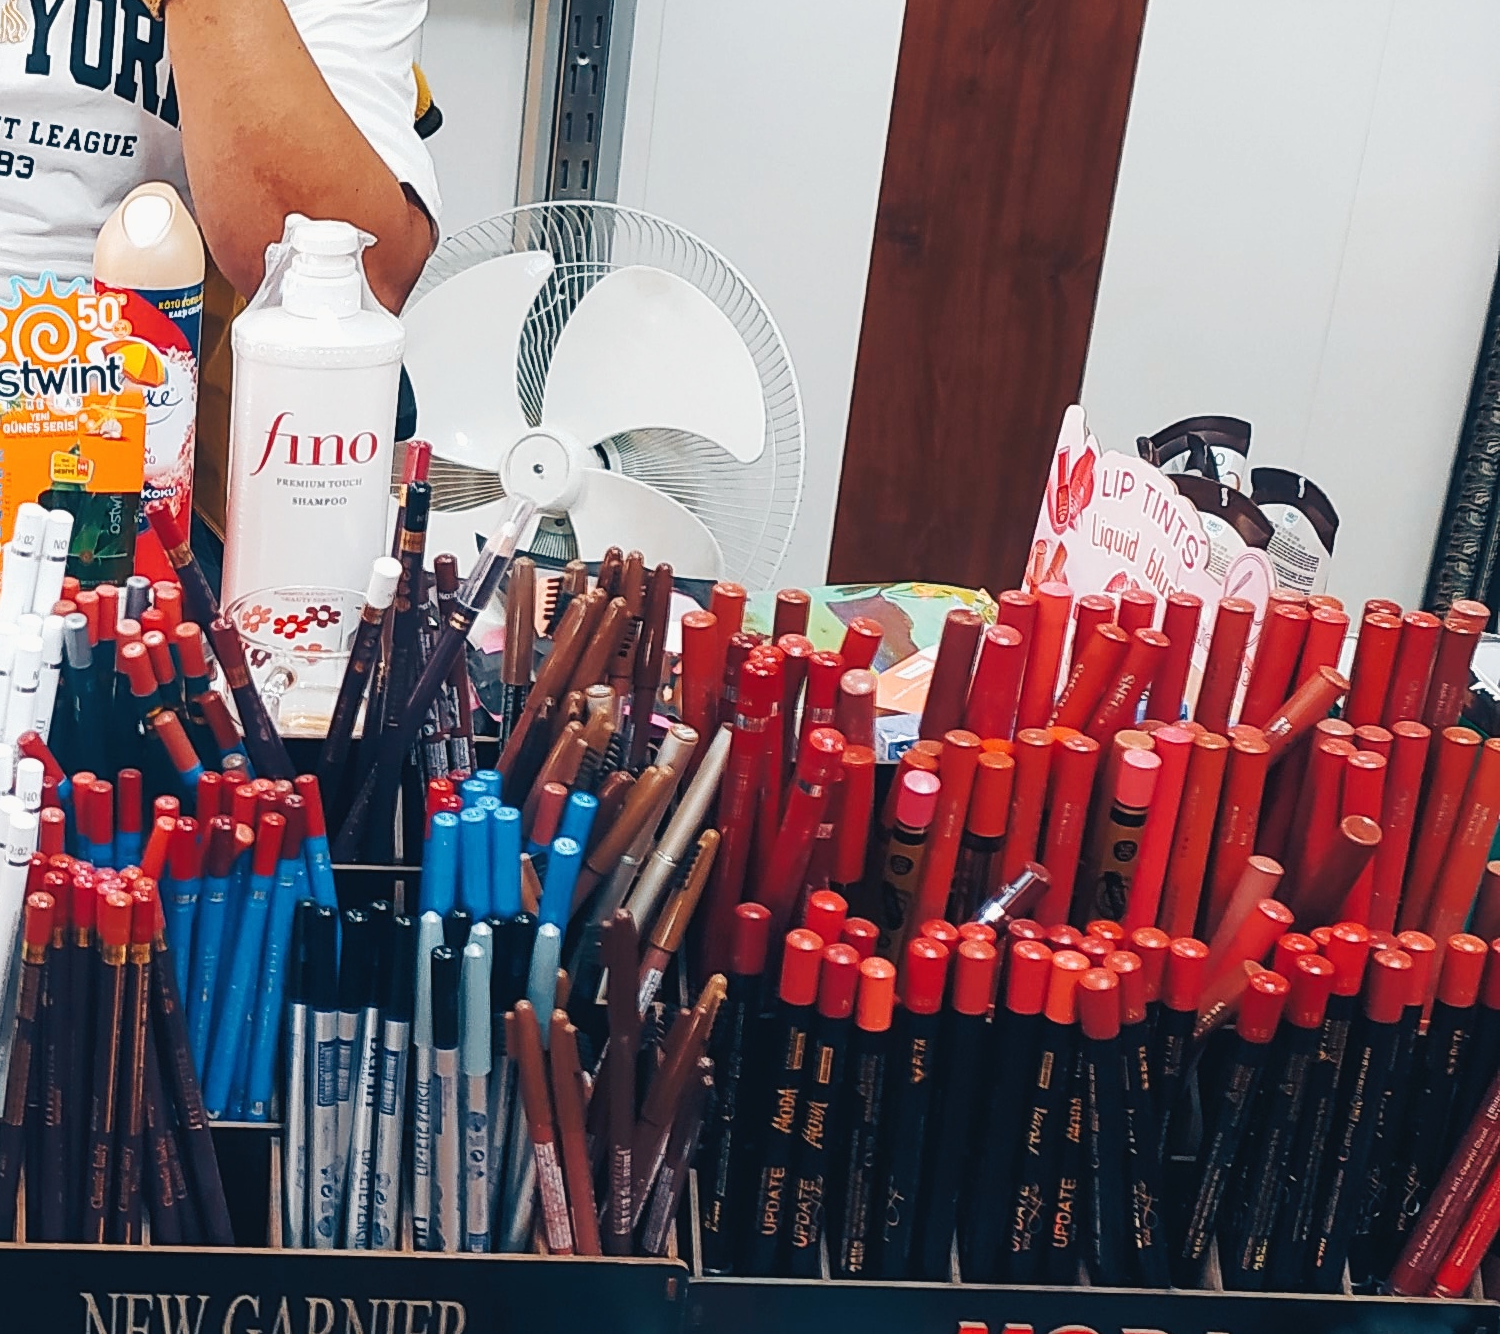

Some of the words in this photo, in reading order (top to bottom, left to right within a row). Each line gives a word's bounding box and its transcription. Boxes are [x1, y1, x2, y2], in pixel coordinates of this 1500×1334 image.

[28, 121, 138, 158] LEAGUE
[3, 421, 40, 435] GÜNEŞ
[250, 412, 378, 476] fino
[276, 478, 326, 488] PREMIUM
[327, 478, 362, 488] TOUCH
[292, 496, 348, 506] SHAMPOO
[1092, 513, 1140, 562] Liquid
[1102, 469, 1135, 499] LIP
[1143, 482, 1198, 569] TINTS
[762, 1167, 785, 1236] UPDATE
[1051, 1177, 1077, 1249] UPDATE
